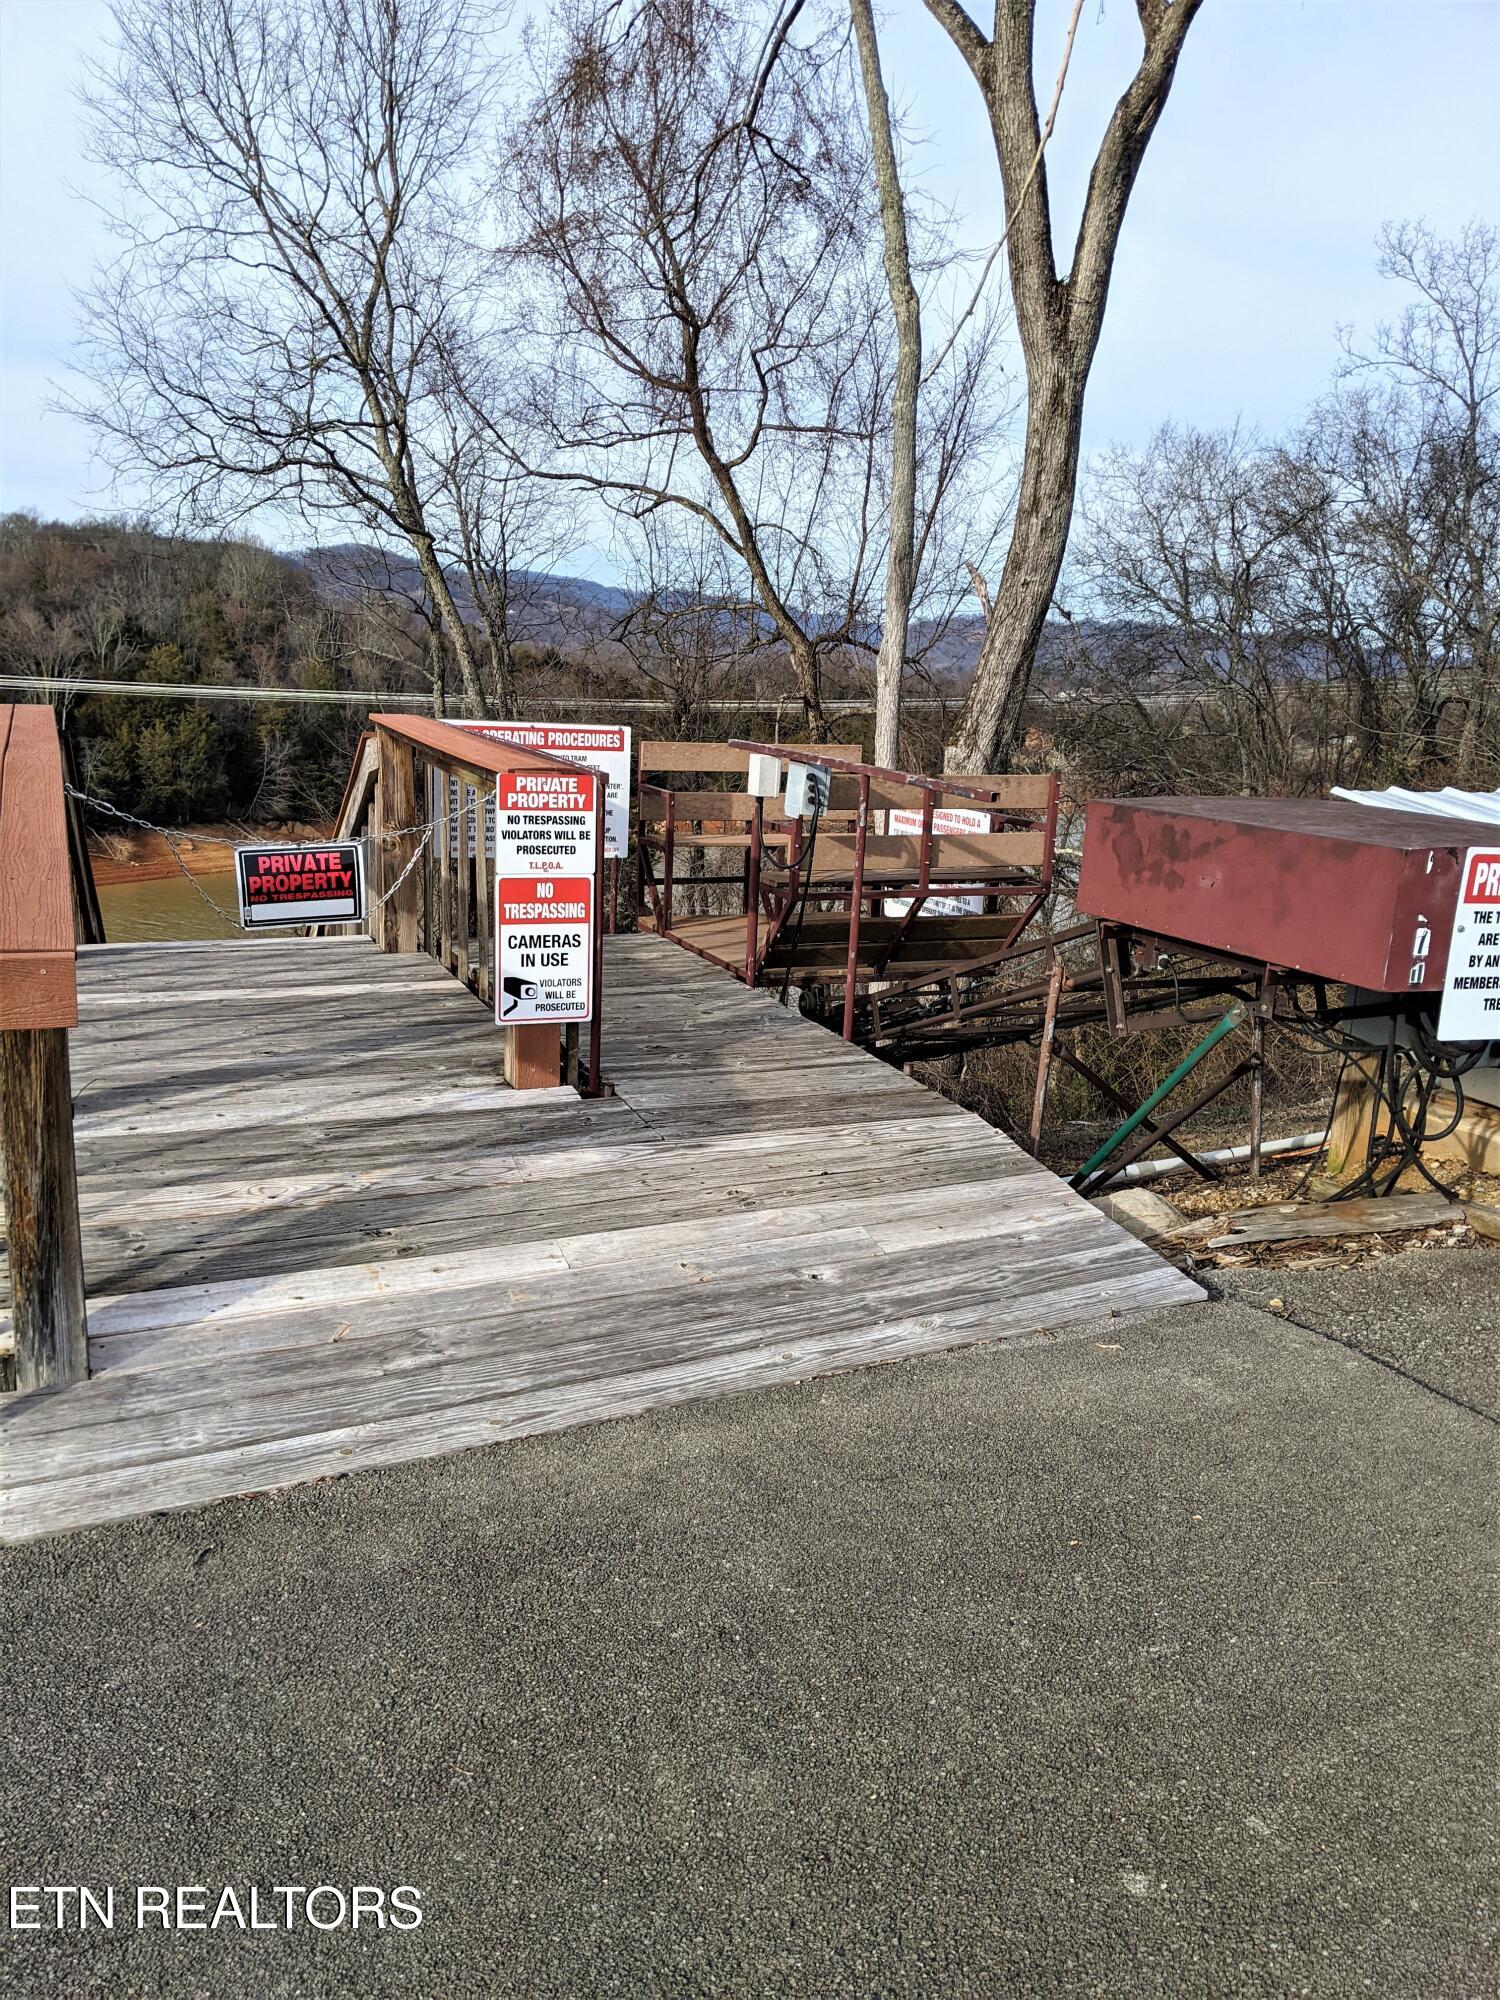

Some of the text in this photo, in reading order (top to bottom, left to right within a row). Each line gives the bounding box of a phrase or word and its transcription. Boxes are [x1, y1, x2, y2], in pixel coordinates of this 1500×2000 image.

[548, 732, 621, 748] PROCEDURES
[516, 777, 578, 793] PRIVATE
[507, 793, 587, 808] PROPERTY
[507, 815, 586, 825] NO TRESPASSING
[501, 830, 552, 840] VIOLATORS
[554, 830, 576, 840] WILL
[579, 830, 591, 840] BE
[516, 845, 577, 855] PROSECUTED
[257, 852, 342, 874] PRIVATE
[248, 870, 353, 894] PROPERTY
[1471, 862, 1500, 897] PR
[250, 889, 354, 903] NO TRESPASSING
[536, 882, 554, 899] NO
[504, 903, 586, 919] TRESPASSING
[1473, 911, 1494, 924] THE
[508, 934, 581, 949] CAMERAS
[1478, 933, 1500, 946] ARE
[520, 953, 569, 967] IN USE
[1468, 955, 1500, 968] BY AN
[539, 978, 582, 988] VIOLATORS
[1453, 976, 1500, 990] MEMBER
[545, 990, 577, 1000] WILL BE
[535, 1002, 586, 1012] PROSECUTED
[1483, 998, 1500, 1011] TRE
